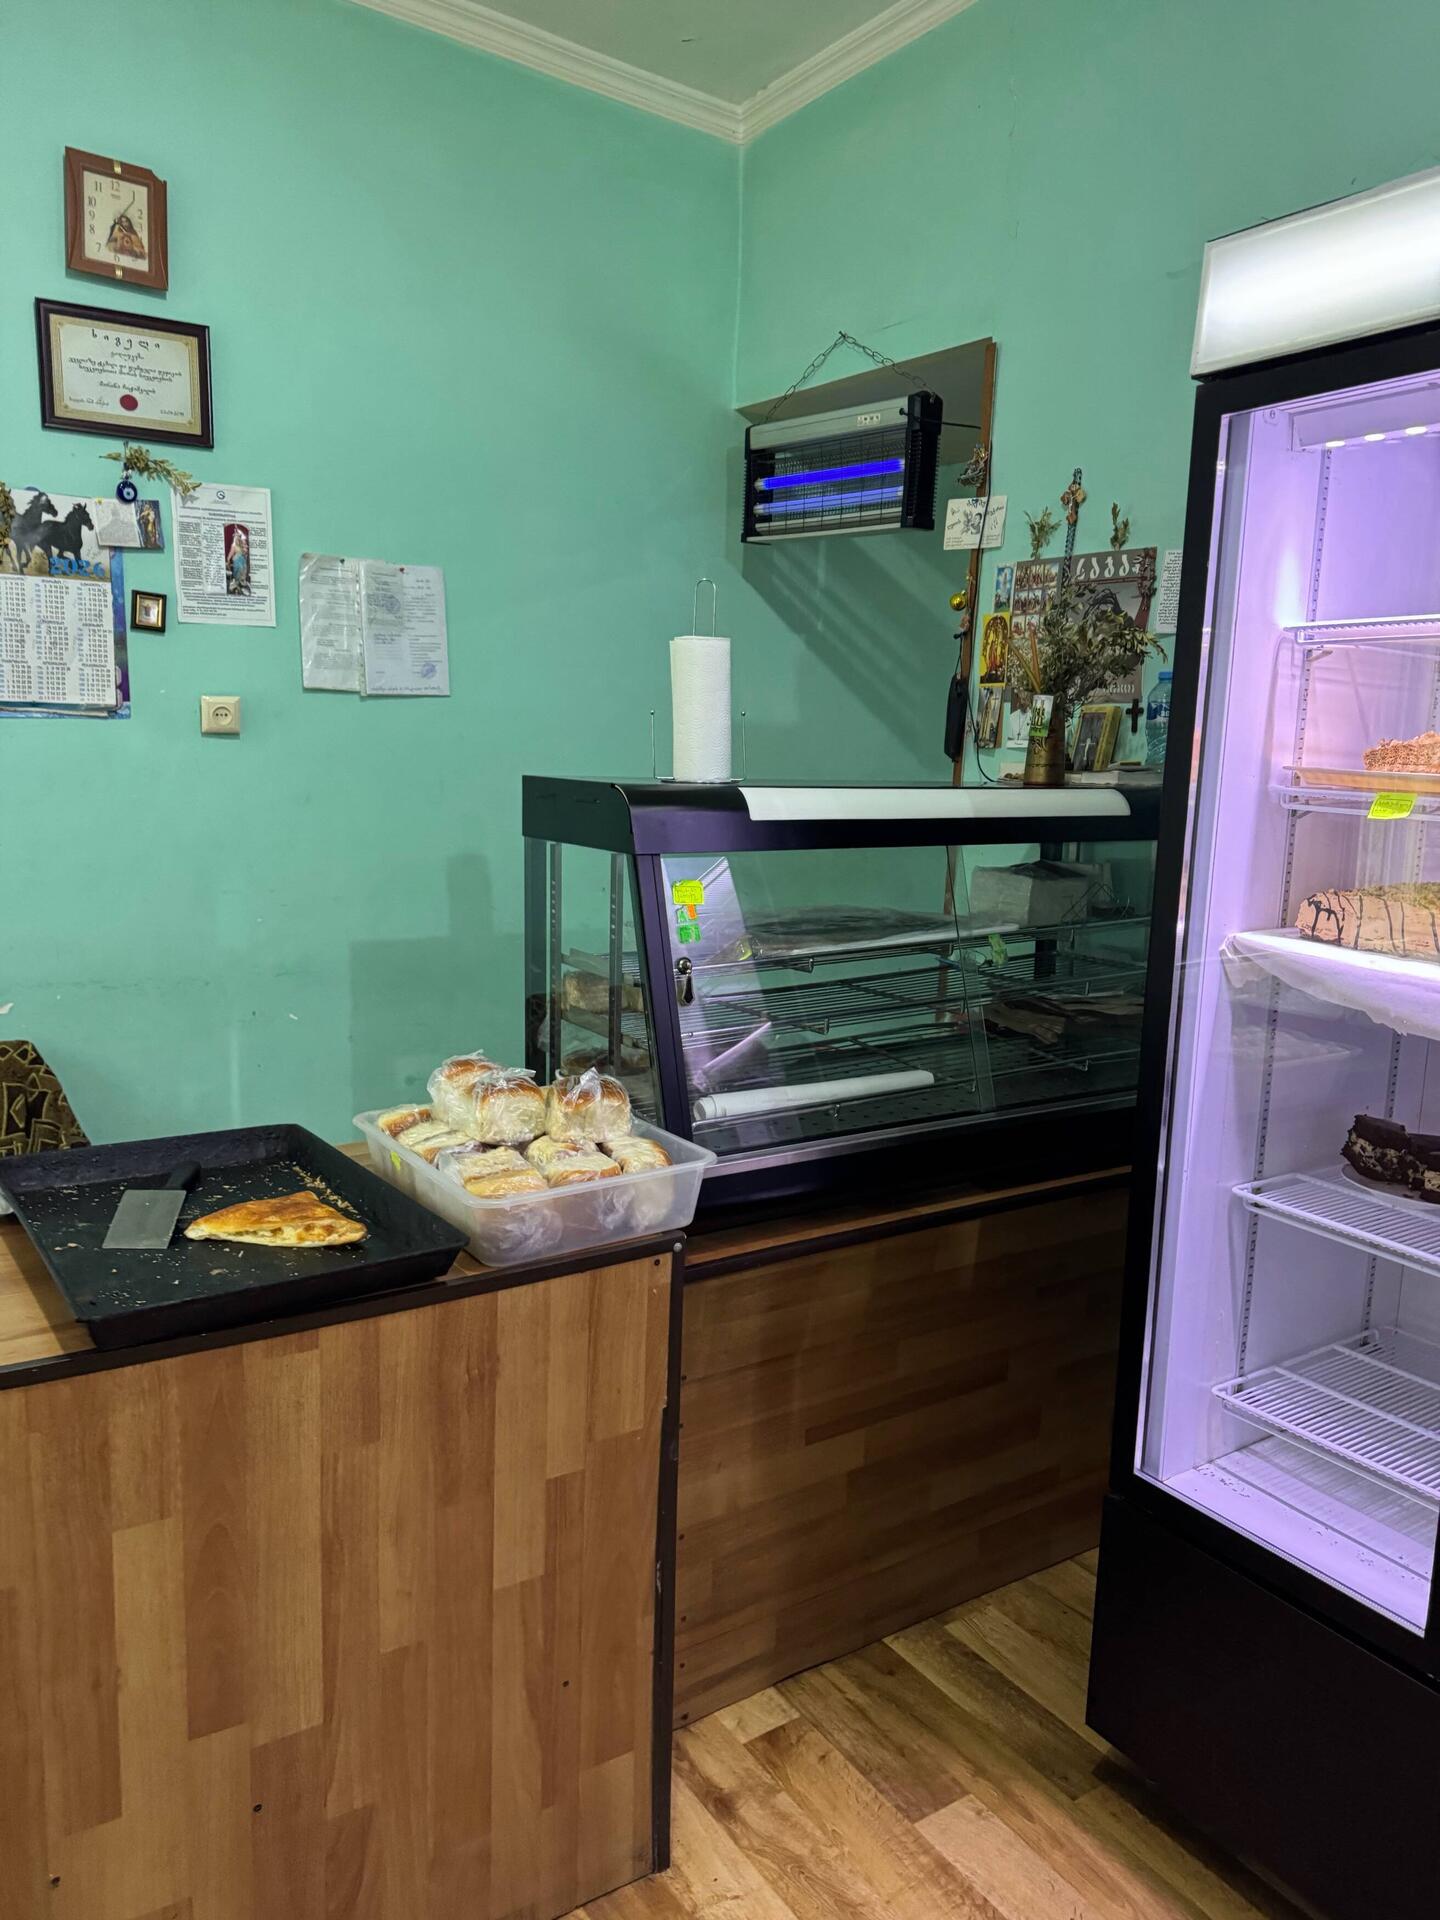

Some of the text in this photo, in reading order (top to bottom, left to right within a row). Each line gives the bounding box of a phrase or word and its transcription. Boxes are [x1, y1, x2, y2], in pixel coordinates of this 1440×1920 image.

[94, 180, 120, 192] 11 12
[88, 196, 97, 207] 10
[88, 210, 96, 221] 9
[89, 224, 96, 235] 8
[95, 242, 102, 253] 7
